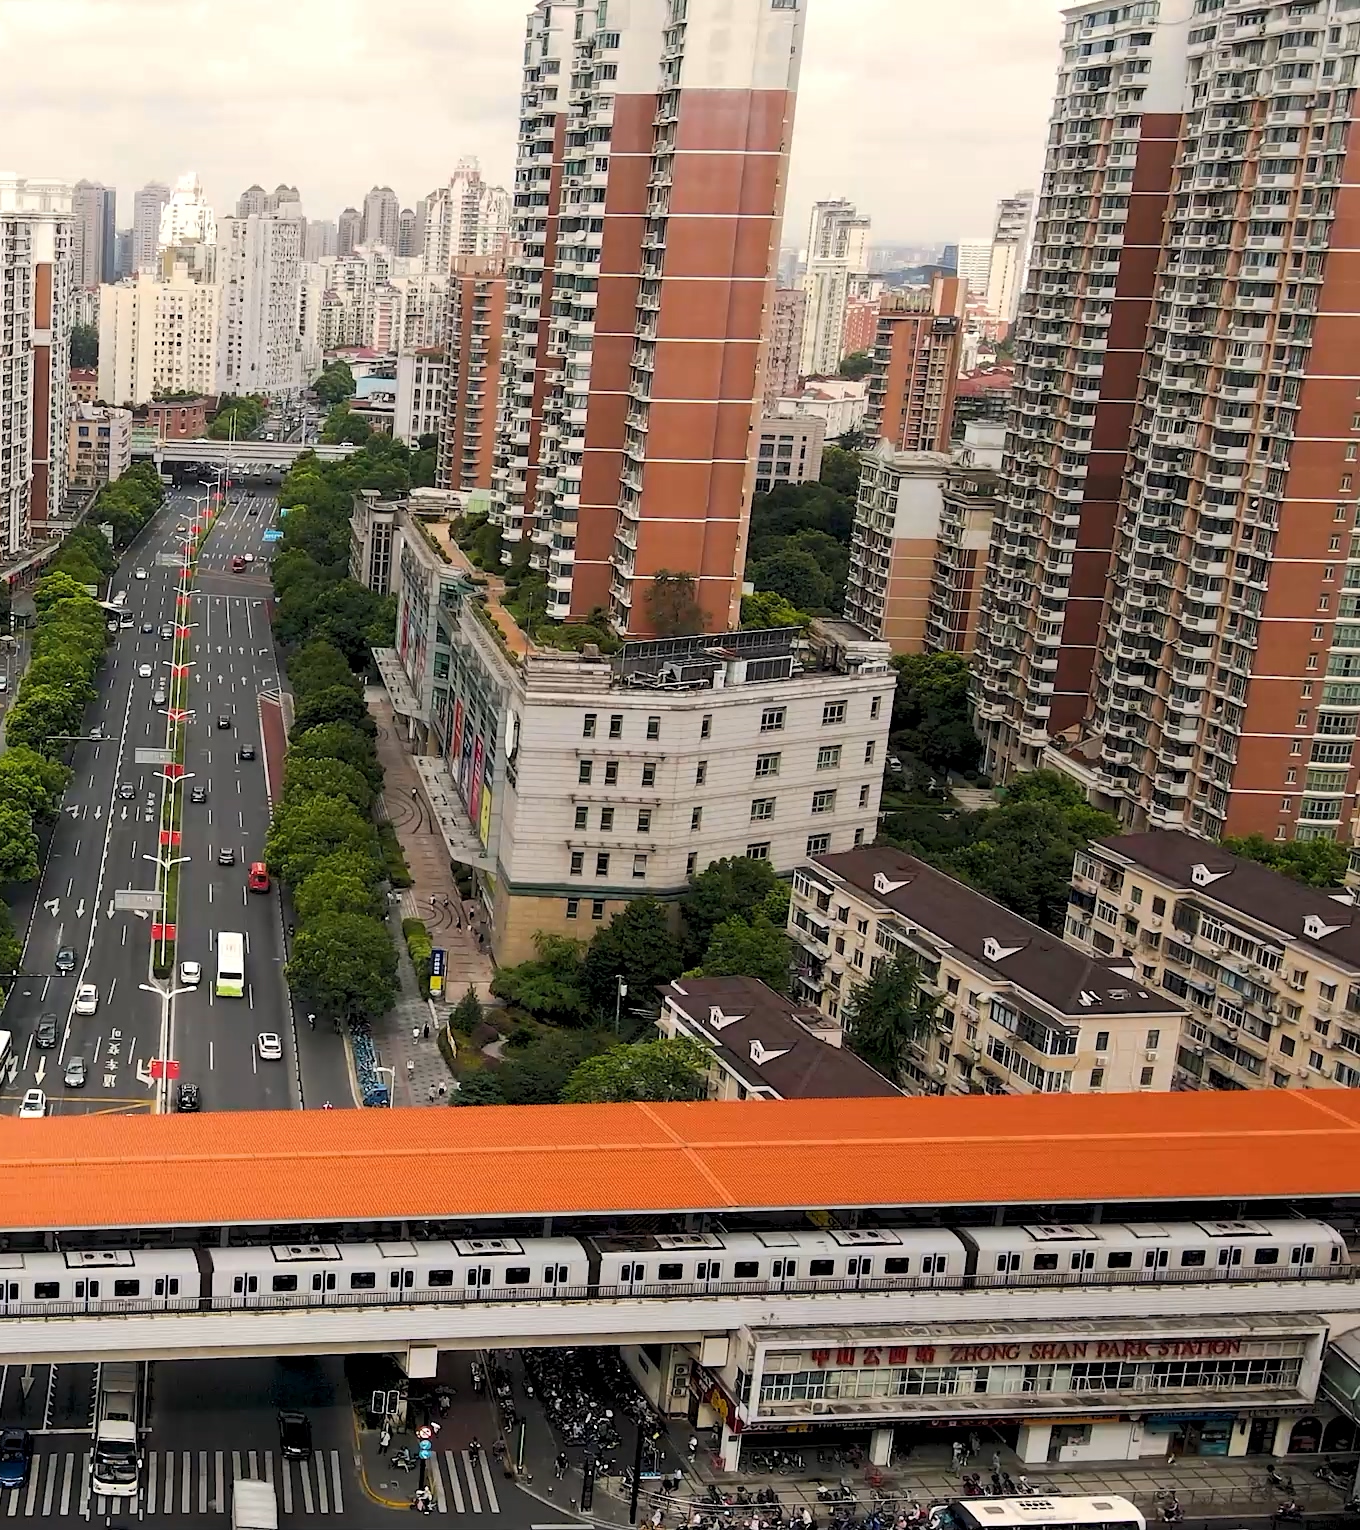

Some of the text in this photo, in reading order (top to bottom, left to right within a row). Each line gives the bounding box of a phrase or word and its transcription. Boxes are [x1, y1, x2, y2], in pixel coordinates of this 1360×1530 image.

[950, 1344, 1020, 1363] ZHONG
[1029, 1342, 1089, 1360] SHAN
[1096, 1340, 1151, 1357] PARK
[1157, 1338, 1242, 1356] STATION
